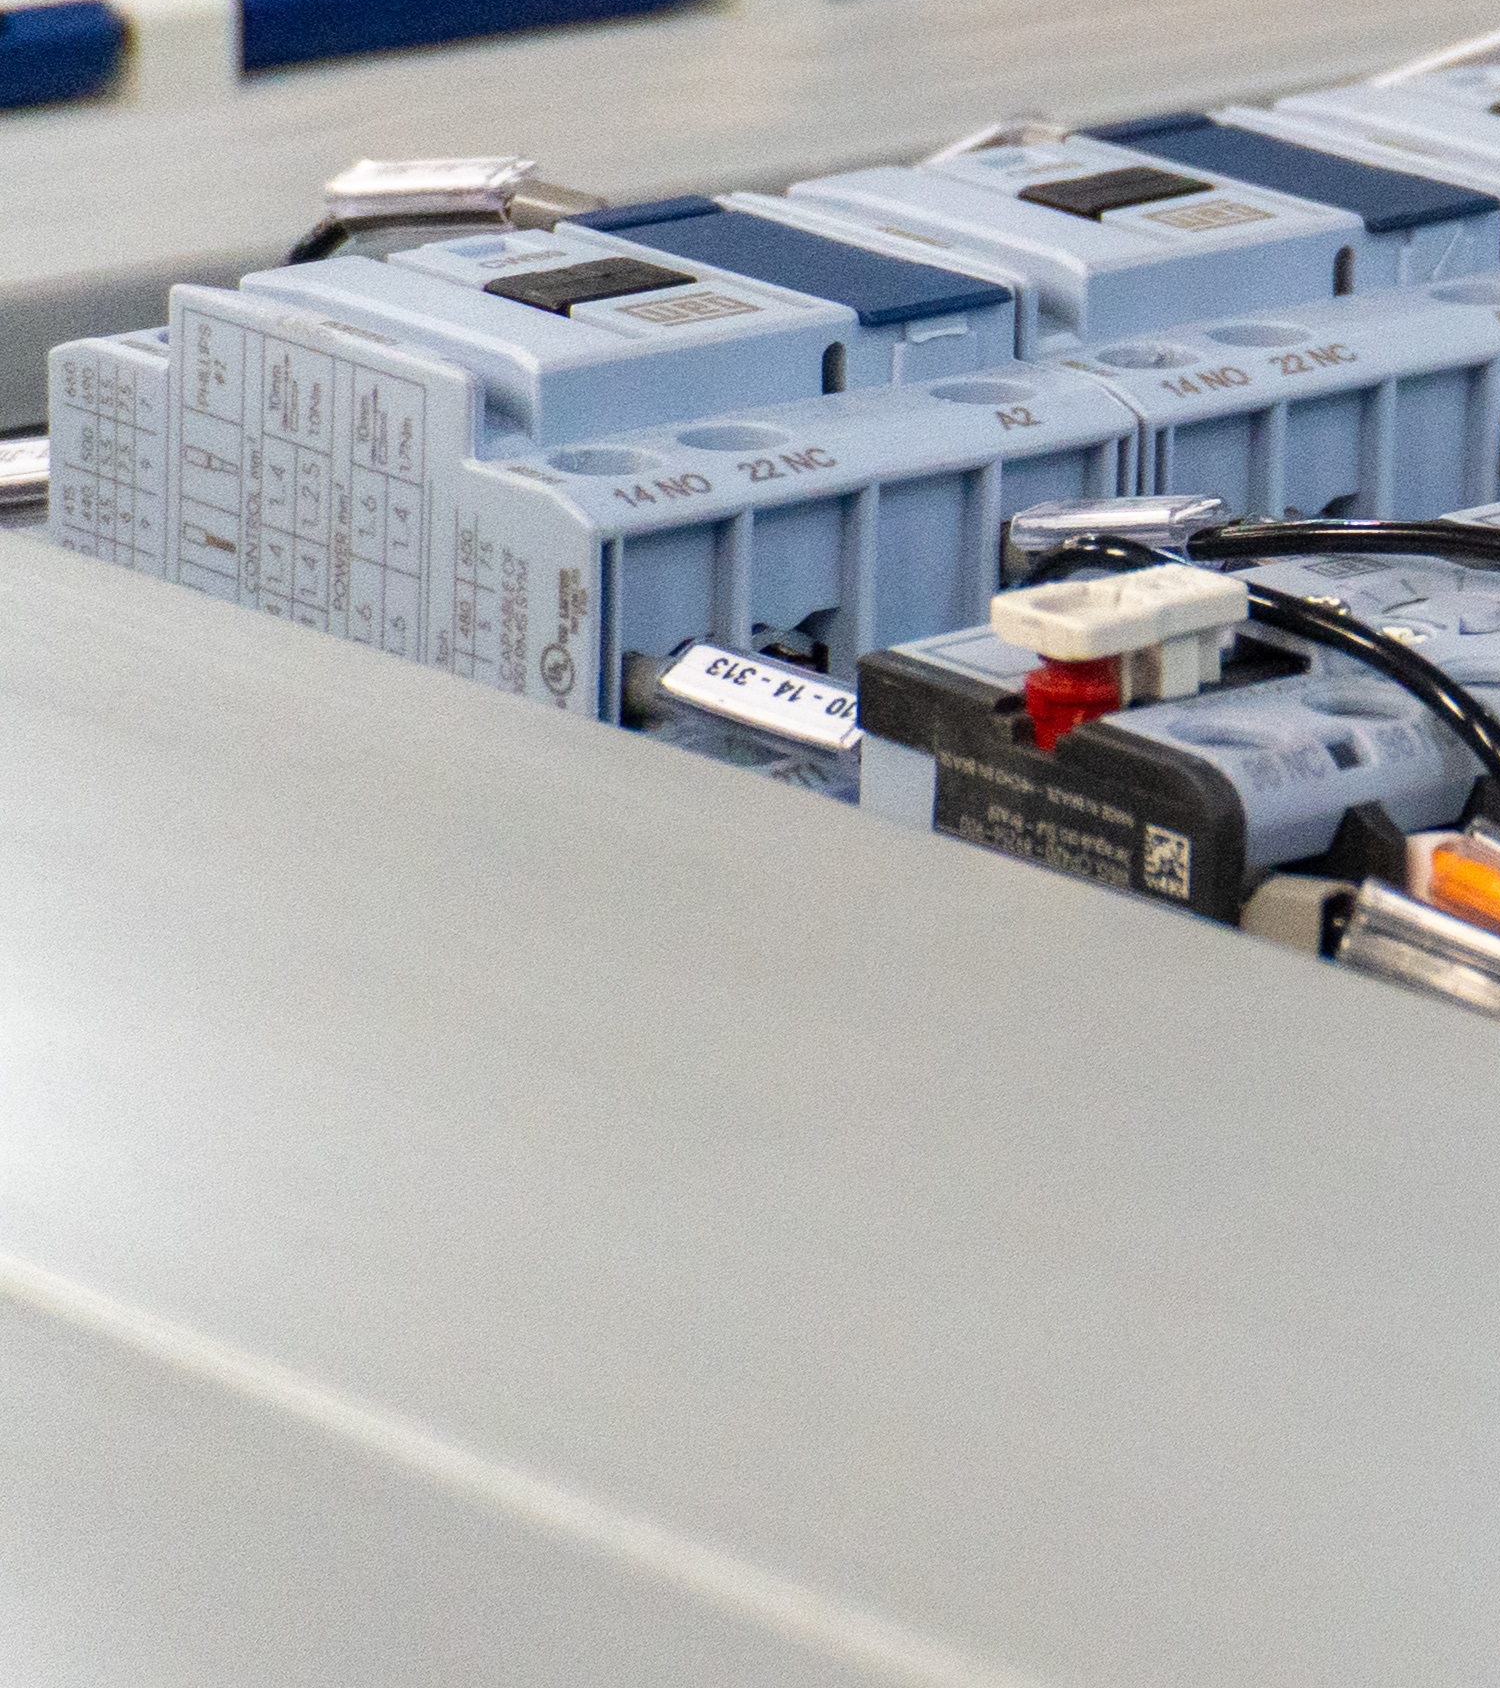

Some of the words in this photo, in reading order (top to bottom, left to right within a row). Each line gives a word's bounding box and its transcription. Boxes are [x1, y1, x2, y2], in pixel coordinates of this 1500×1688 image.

[1268, 353, 1315, 376] 22
[1304, 342, 1358, 369] NC
[1160, 378, 1203, 400] 14
[1198, 364, 1253, 391] NO
[995, 406, 1043, 431] A2
[737, 459, 787, 483] 22
[779, 446, 838, 474] NC
[612, 484, 656, 509] 14
[653, 472, 713, 499] NO
[245, 490, 262, 595] CONTROL
[332, 531, 349, 612] POWER
[704, 657, 757, 686] 313
[772, 679, 806, 702] 14
